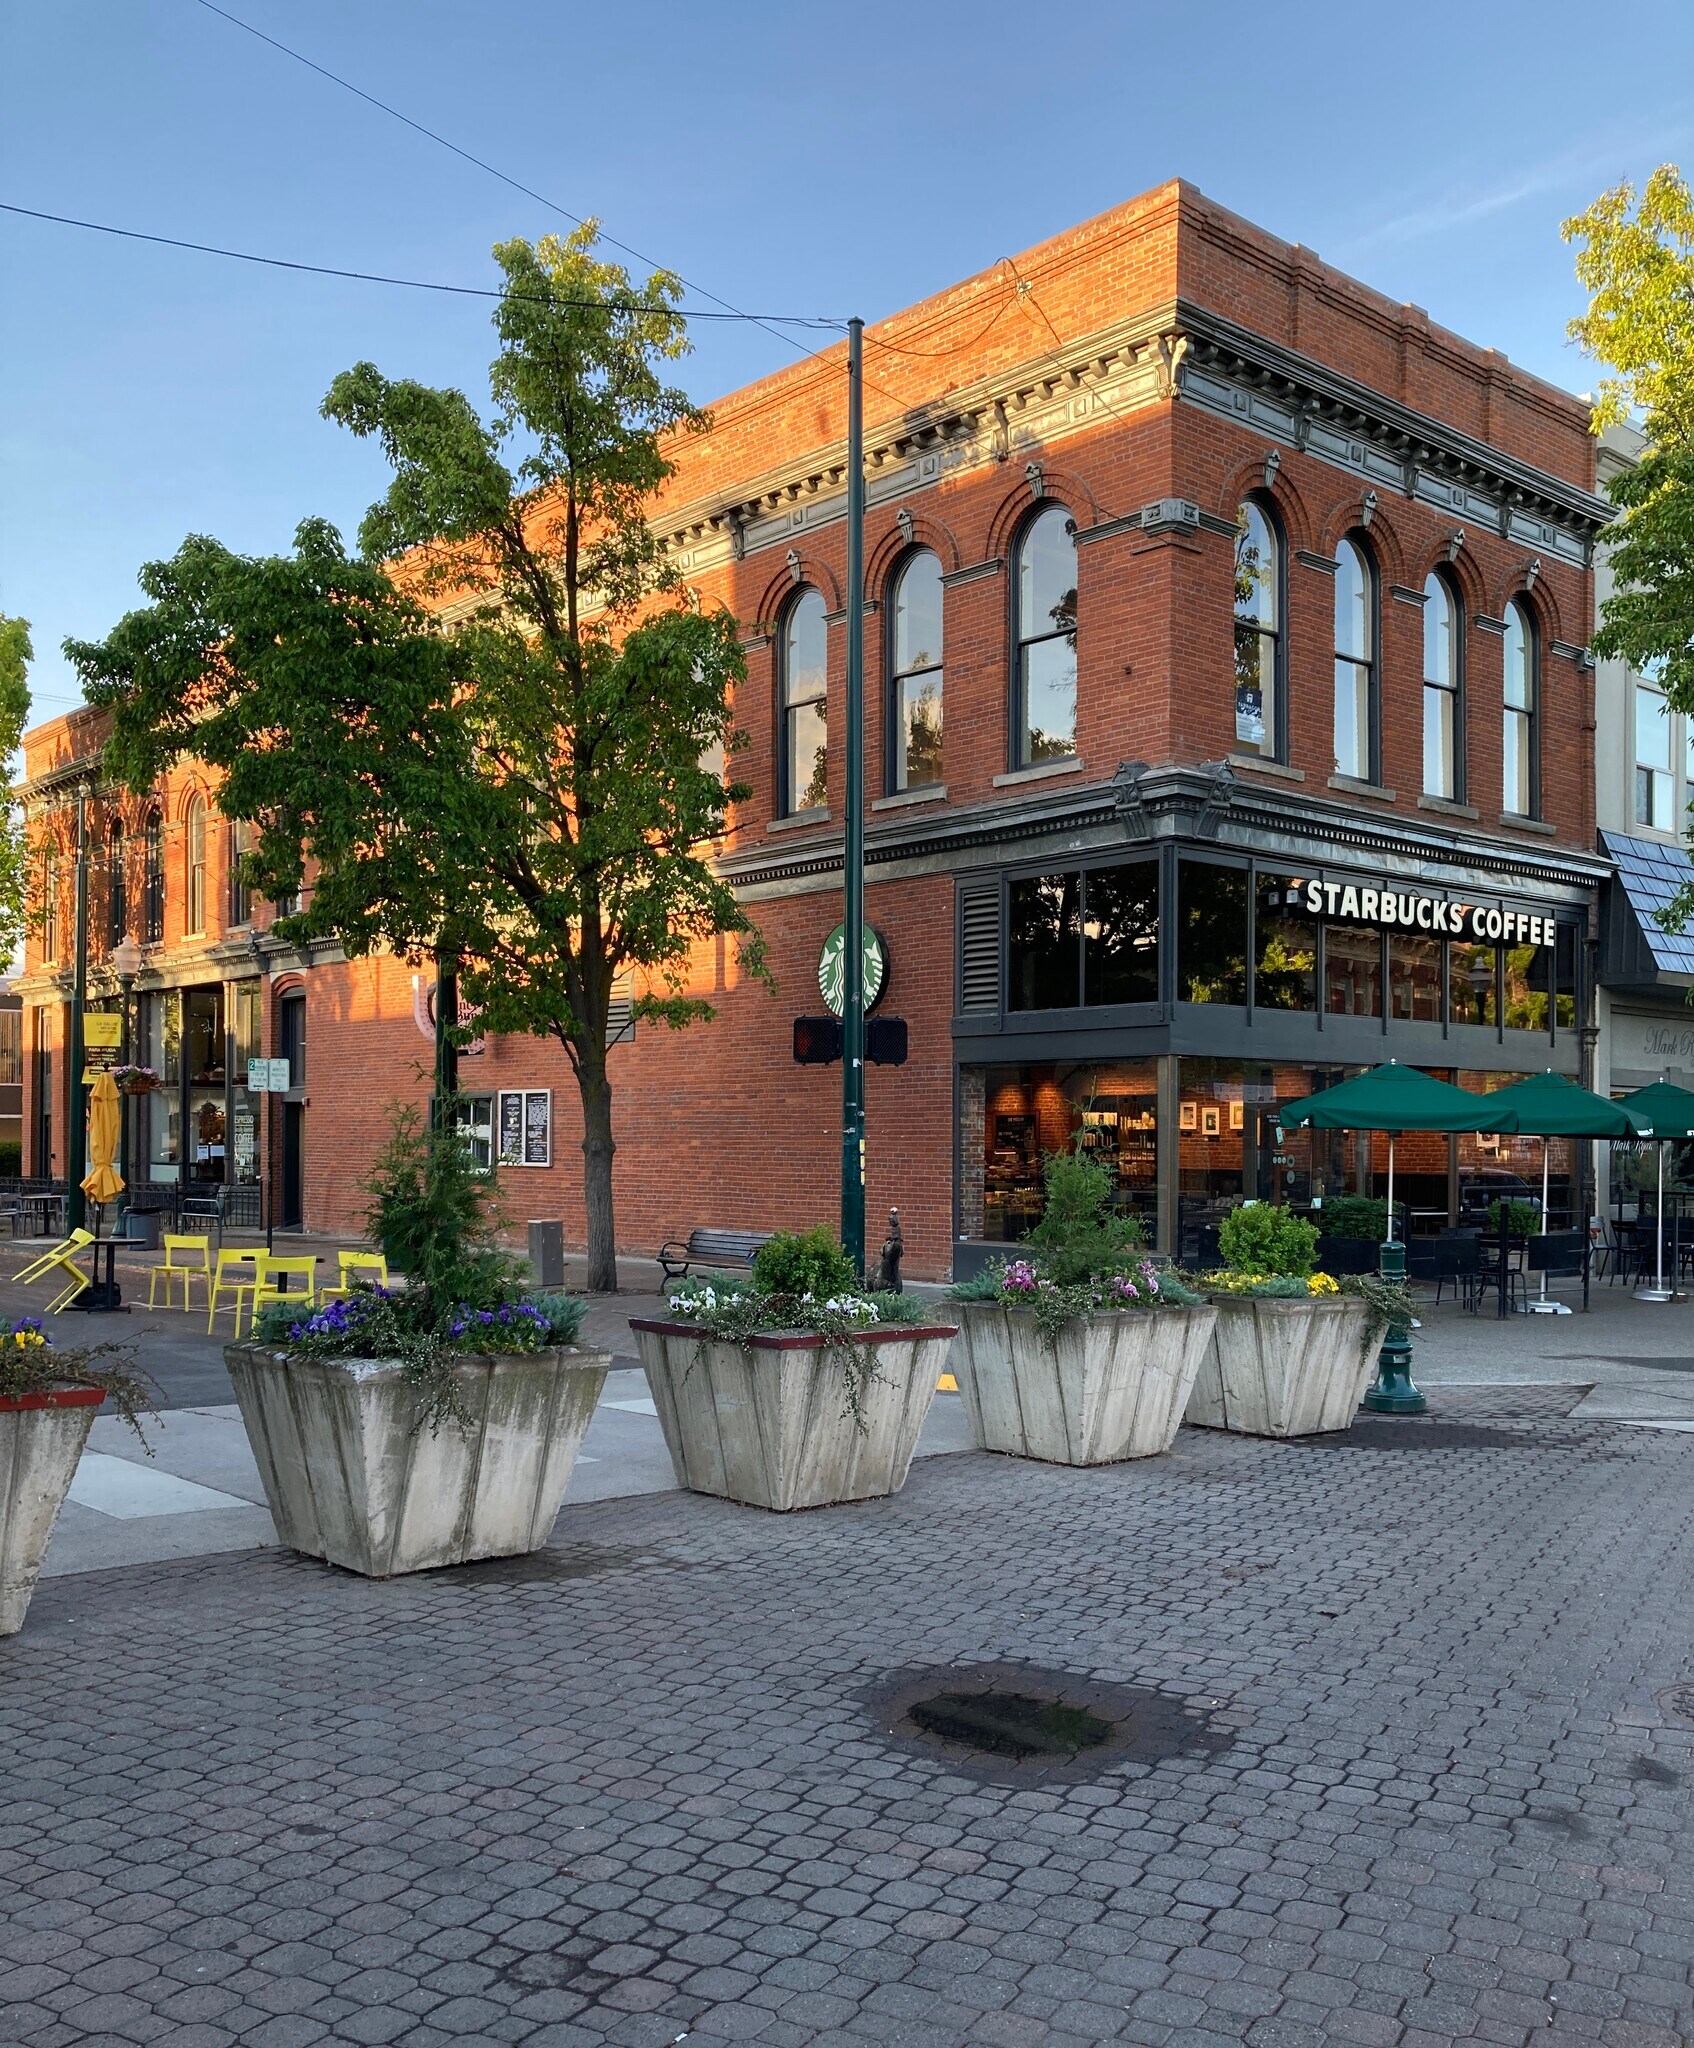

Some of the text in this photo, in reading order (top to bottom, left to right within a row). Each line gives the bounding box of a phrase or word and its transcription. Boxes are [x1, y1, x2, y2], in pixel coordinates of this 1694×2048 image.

[1306, 879, 1555, 946] STARBUCKS COFFEE
[1644, 1026, 1678, 1055] Mark
[250, 1060, 255, 1070] 2
[234, 1115, 254, 1124] ESPRESSO
[234, 1133, 254, 1144] COFFEE
